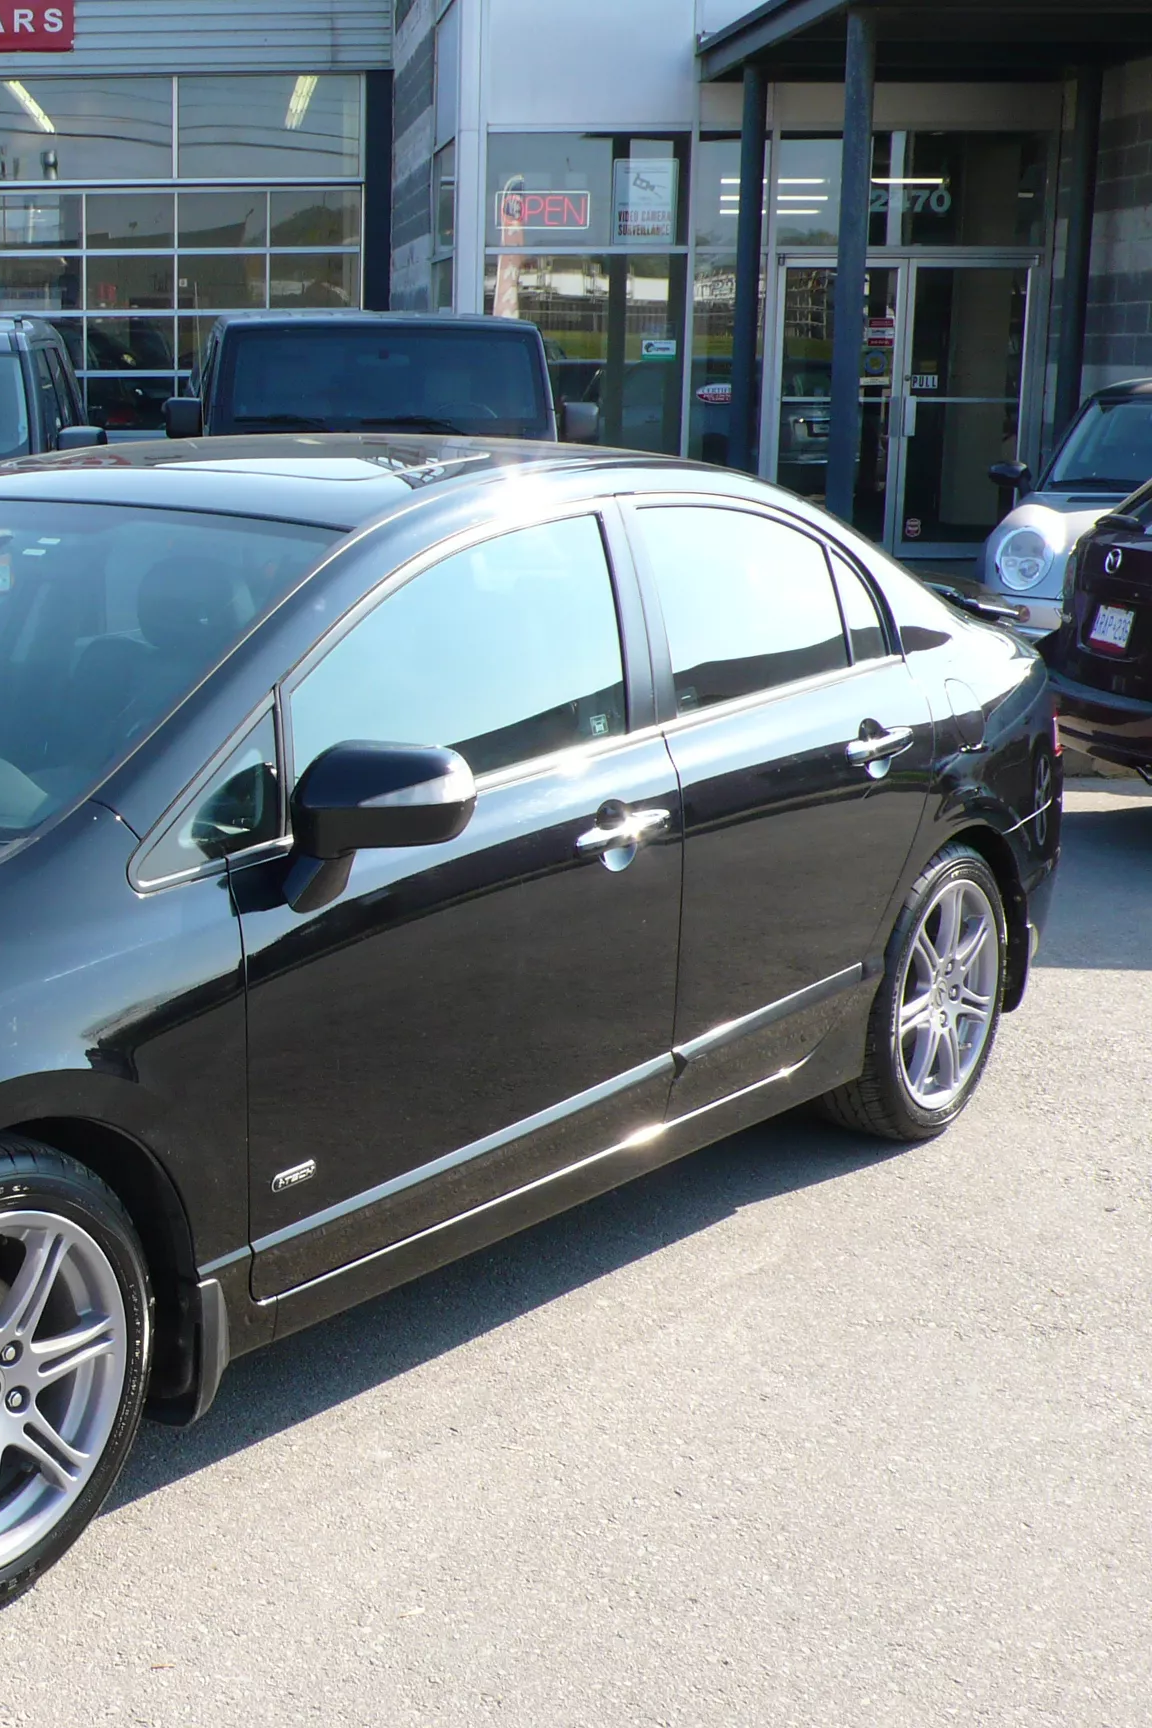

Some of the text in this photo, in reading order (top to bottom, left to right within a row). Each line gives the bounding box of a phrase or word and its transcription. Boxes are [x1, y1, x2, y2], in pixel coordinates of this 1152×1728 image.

[503, 194, 586, 225] OPEN
[617, 209, 672, 222] VIDEO CAMERA
[617, 224, 670, 236] SURVEILLANCE
[912, 375, 937, 387] PULL
